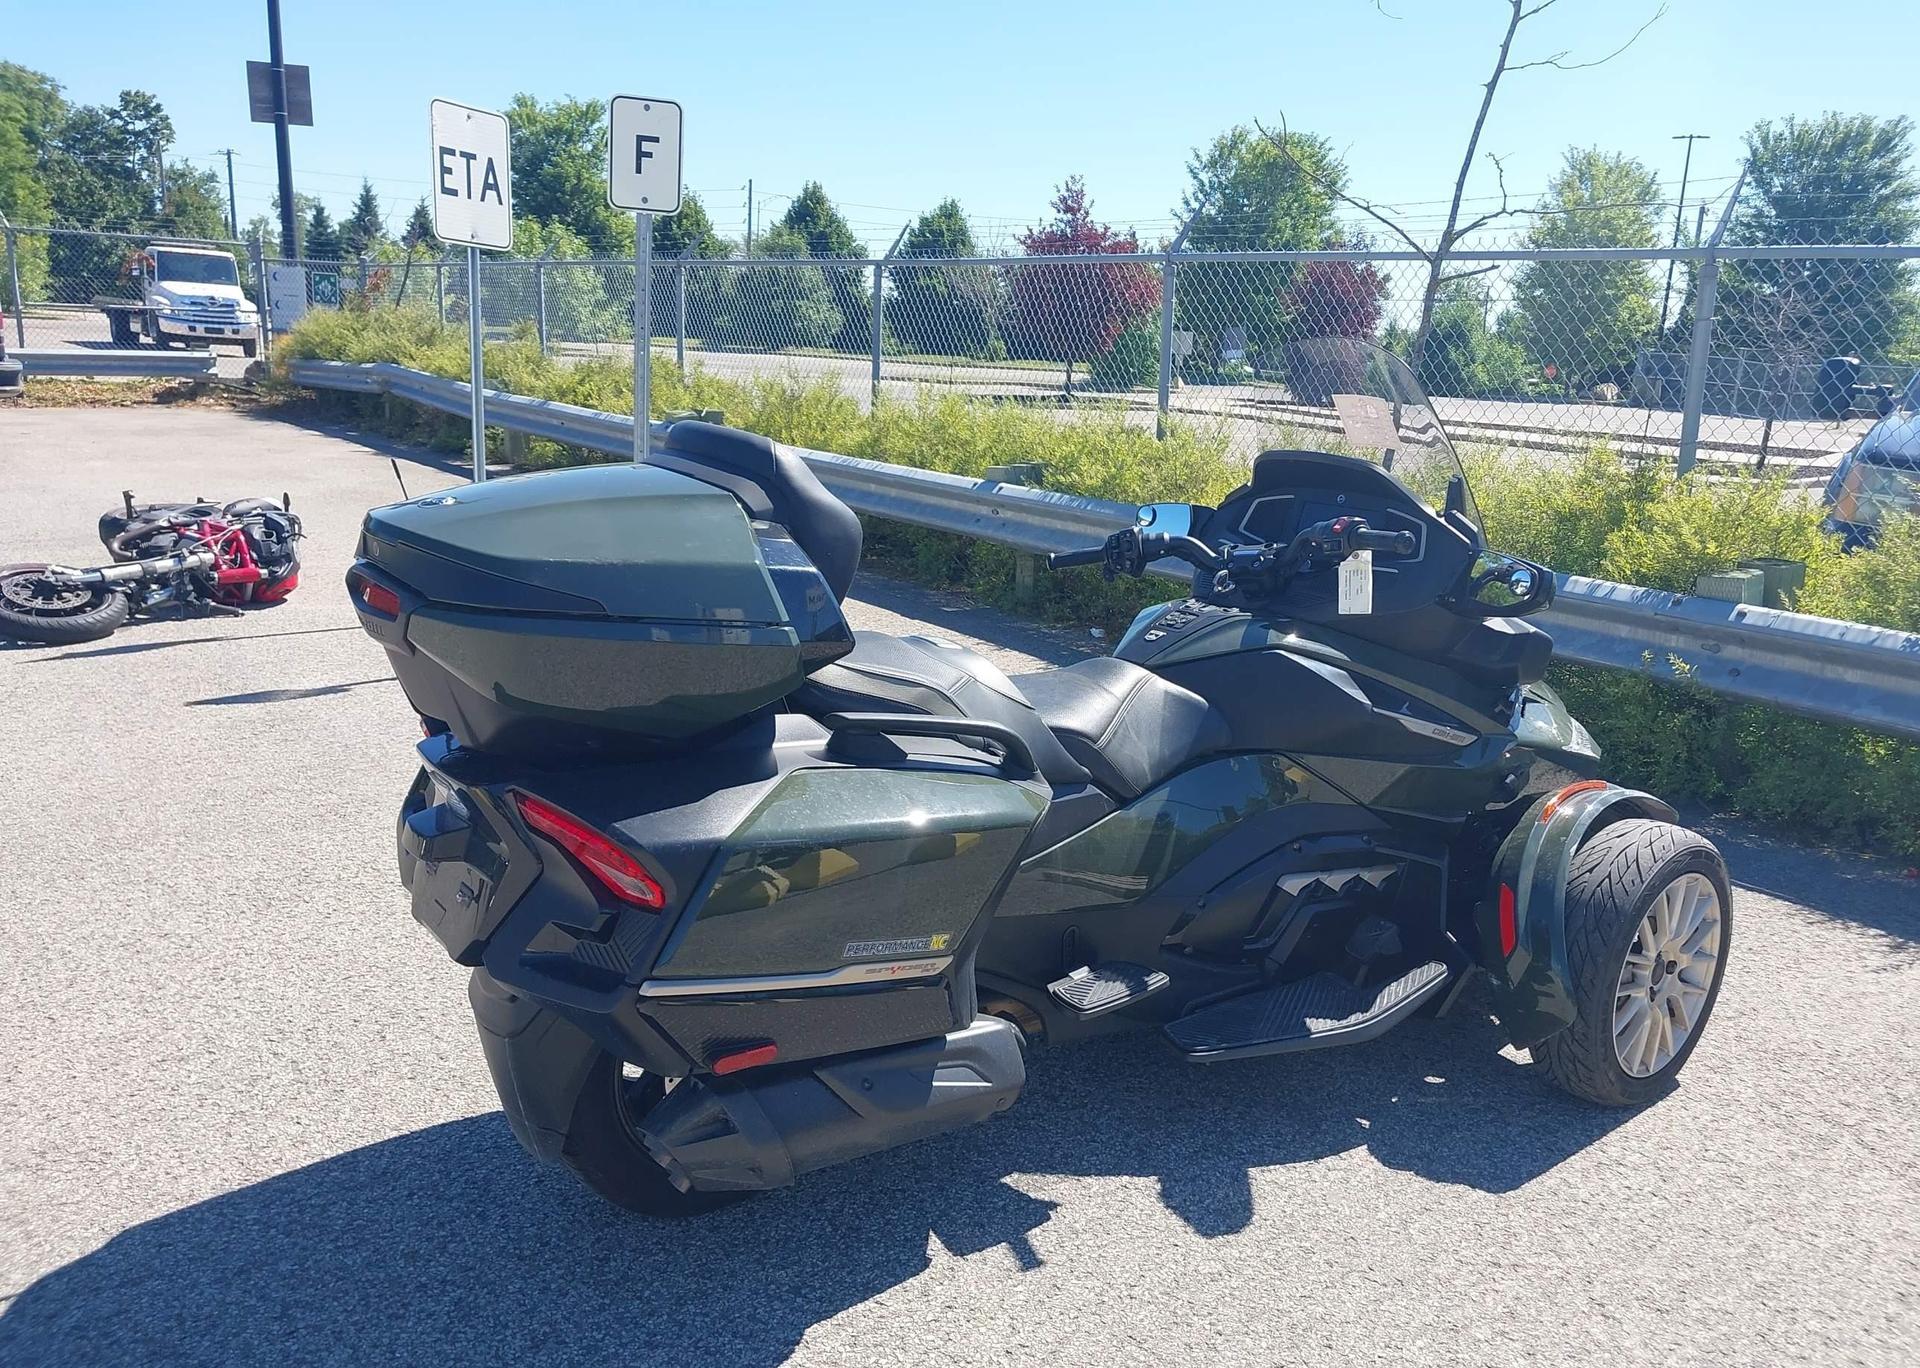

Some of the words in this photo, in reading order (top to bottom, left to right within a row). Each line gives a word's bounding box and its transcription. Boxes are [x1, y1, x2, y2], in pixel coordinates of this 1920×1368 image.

[634, 134, 660, 175] F
[438, 146, 504, 206] ETA
[844, 940, 930, 956] PERFORMANCE
